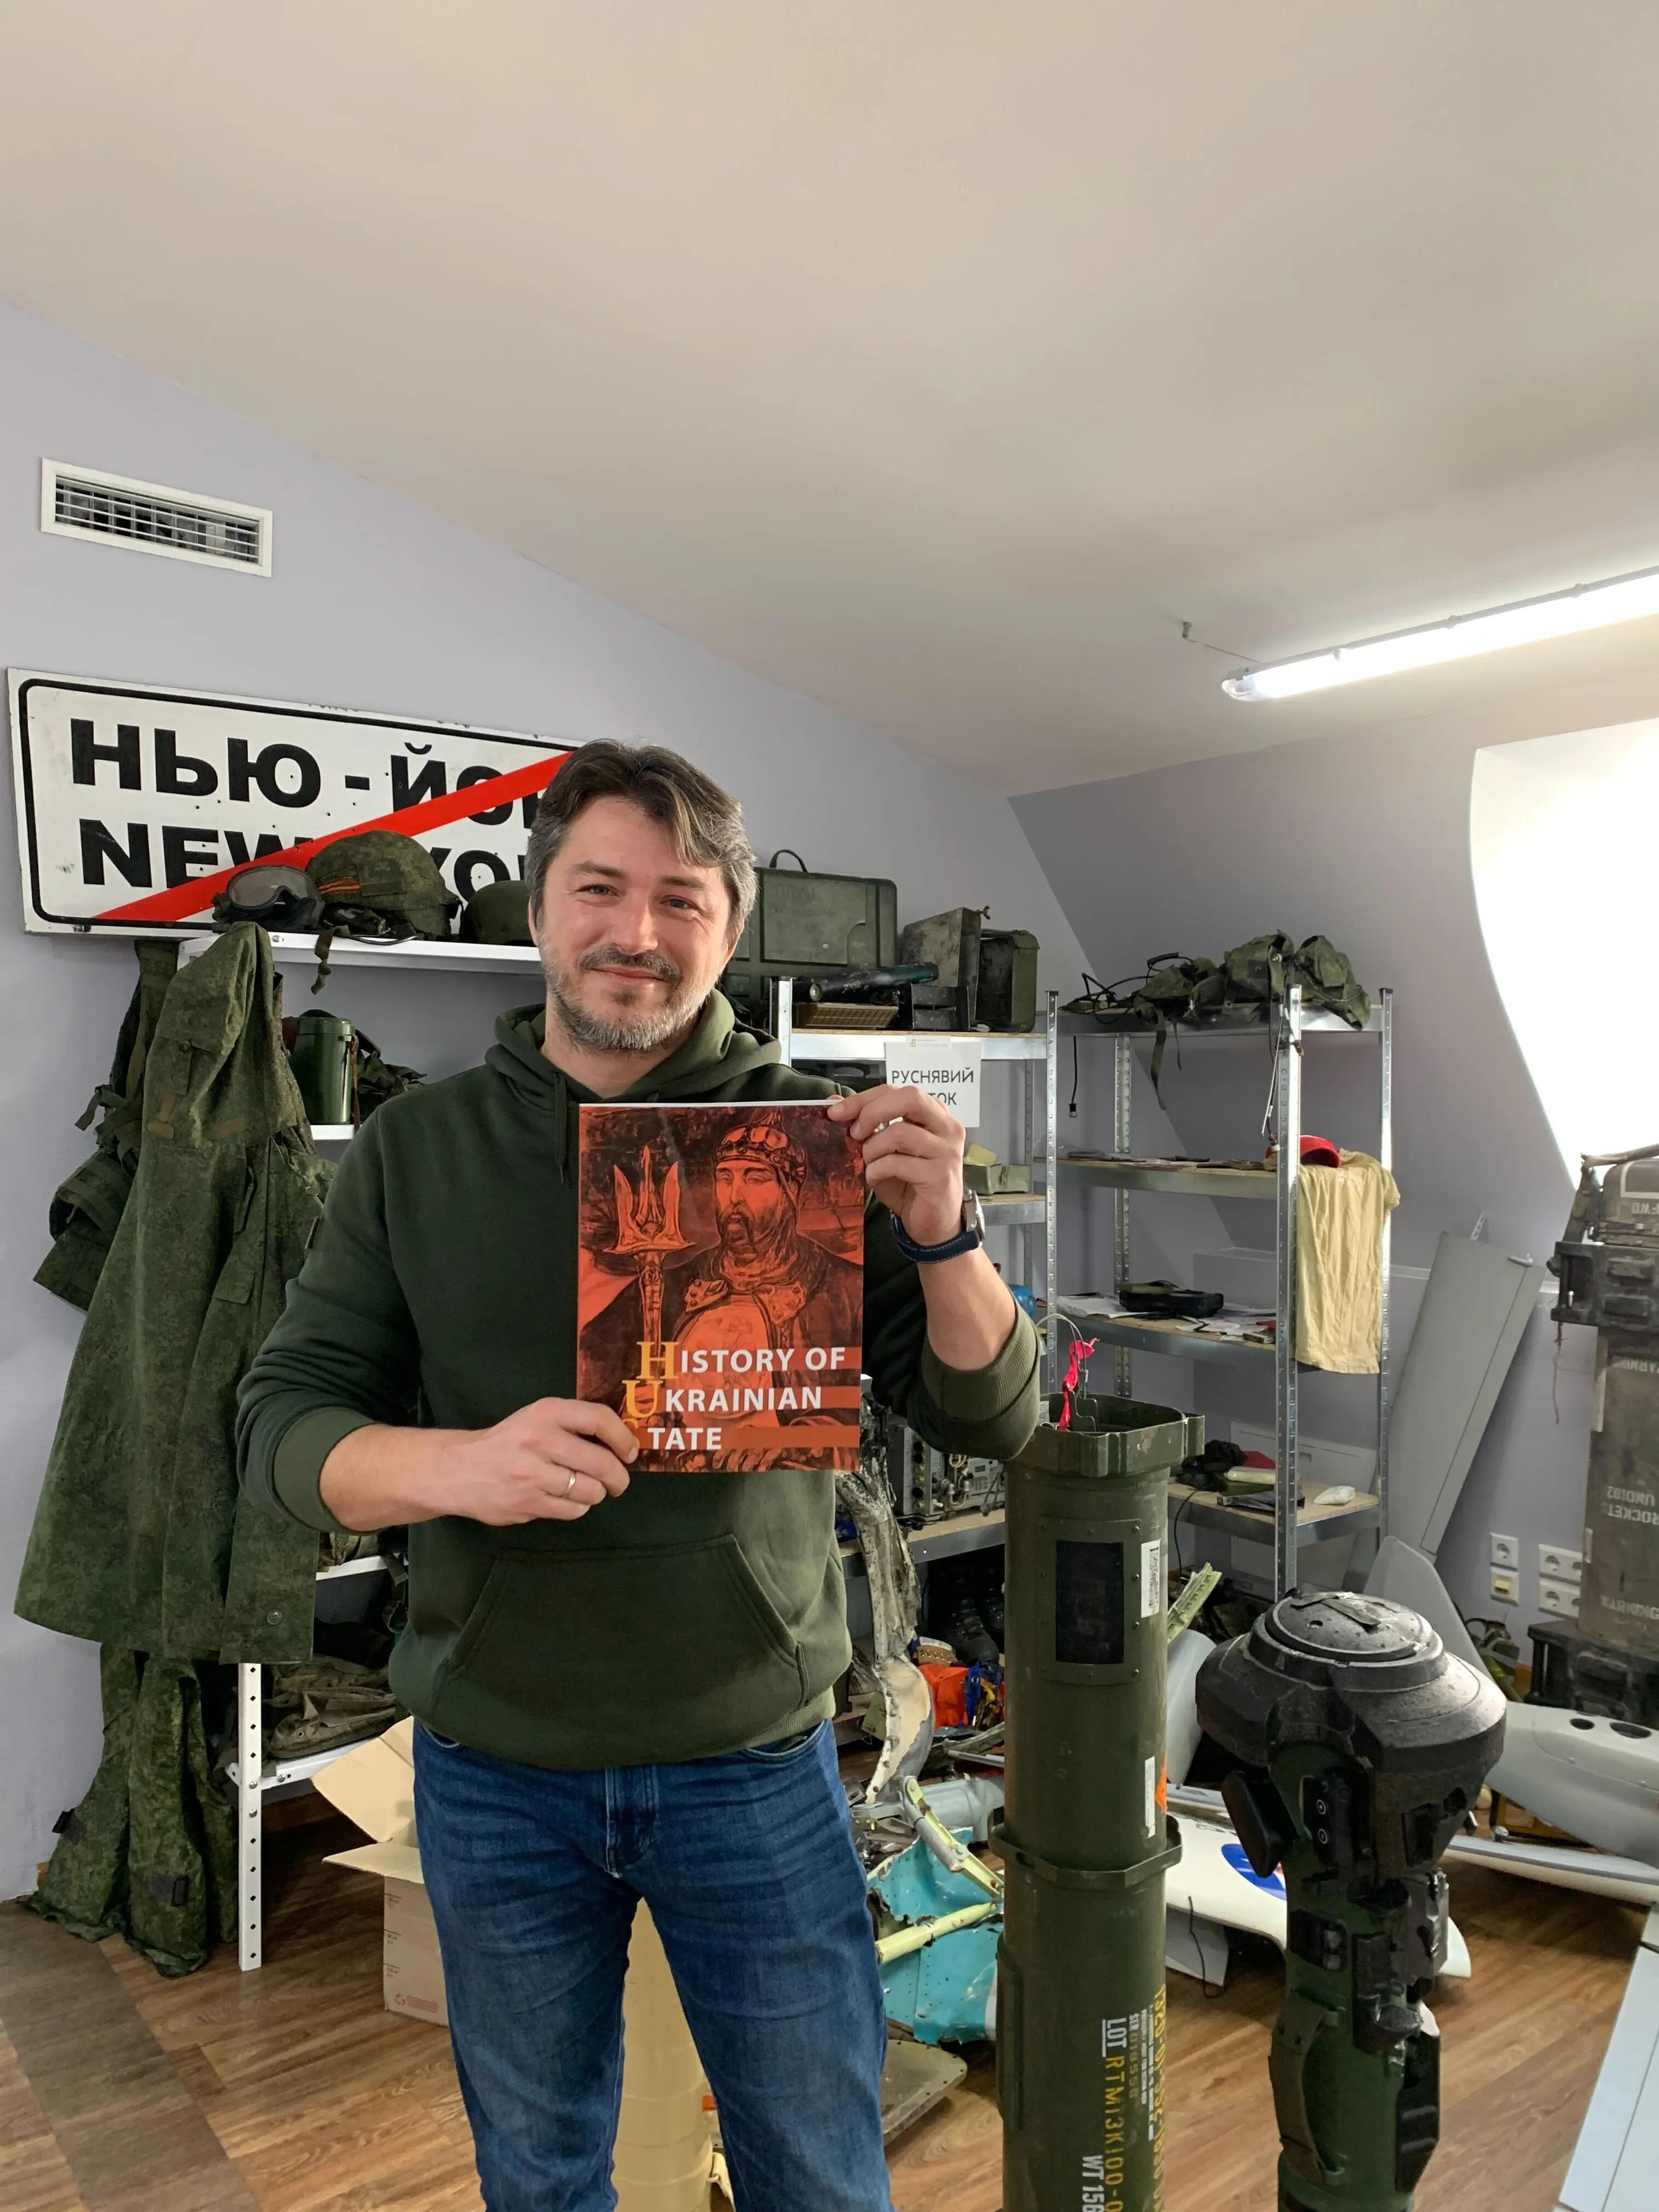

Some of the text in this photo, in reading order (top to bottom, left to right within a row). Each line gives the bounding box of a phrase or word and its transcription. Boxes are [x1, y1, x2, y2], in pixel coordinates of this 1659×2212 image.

[71, 718, 321, 808] НЬЮ
[891, 1066, 974, 1084] РУСНЯВИЙ
[636, 1342, 846, 1379] HISTORY OF
[622, 1380, 821, 1419] UKRAINIAN
[1107, 2018, 1127, 2048] LOT
[1082, 2155, 1104, 2180] WT
